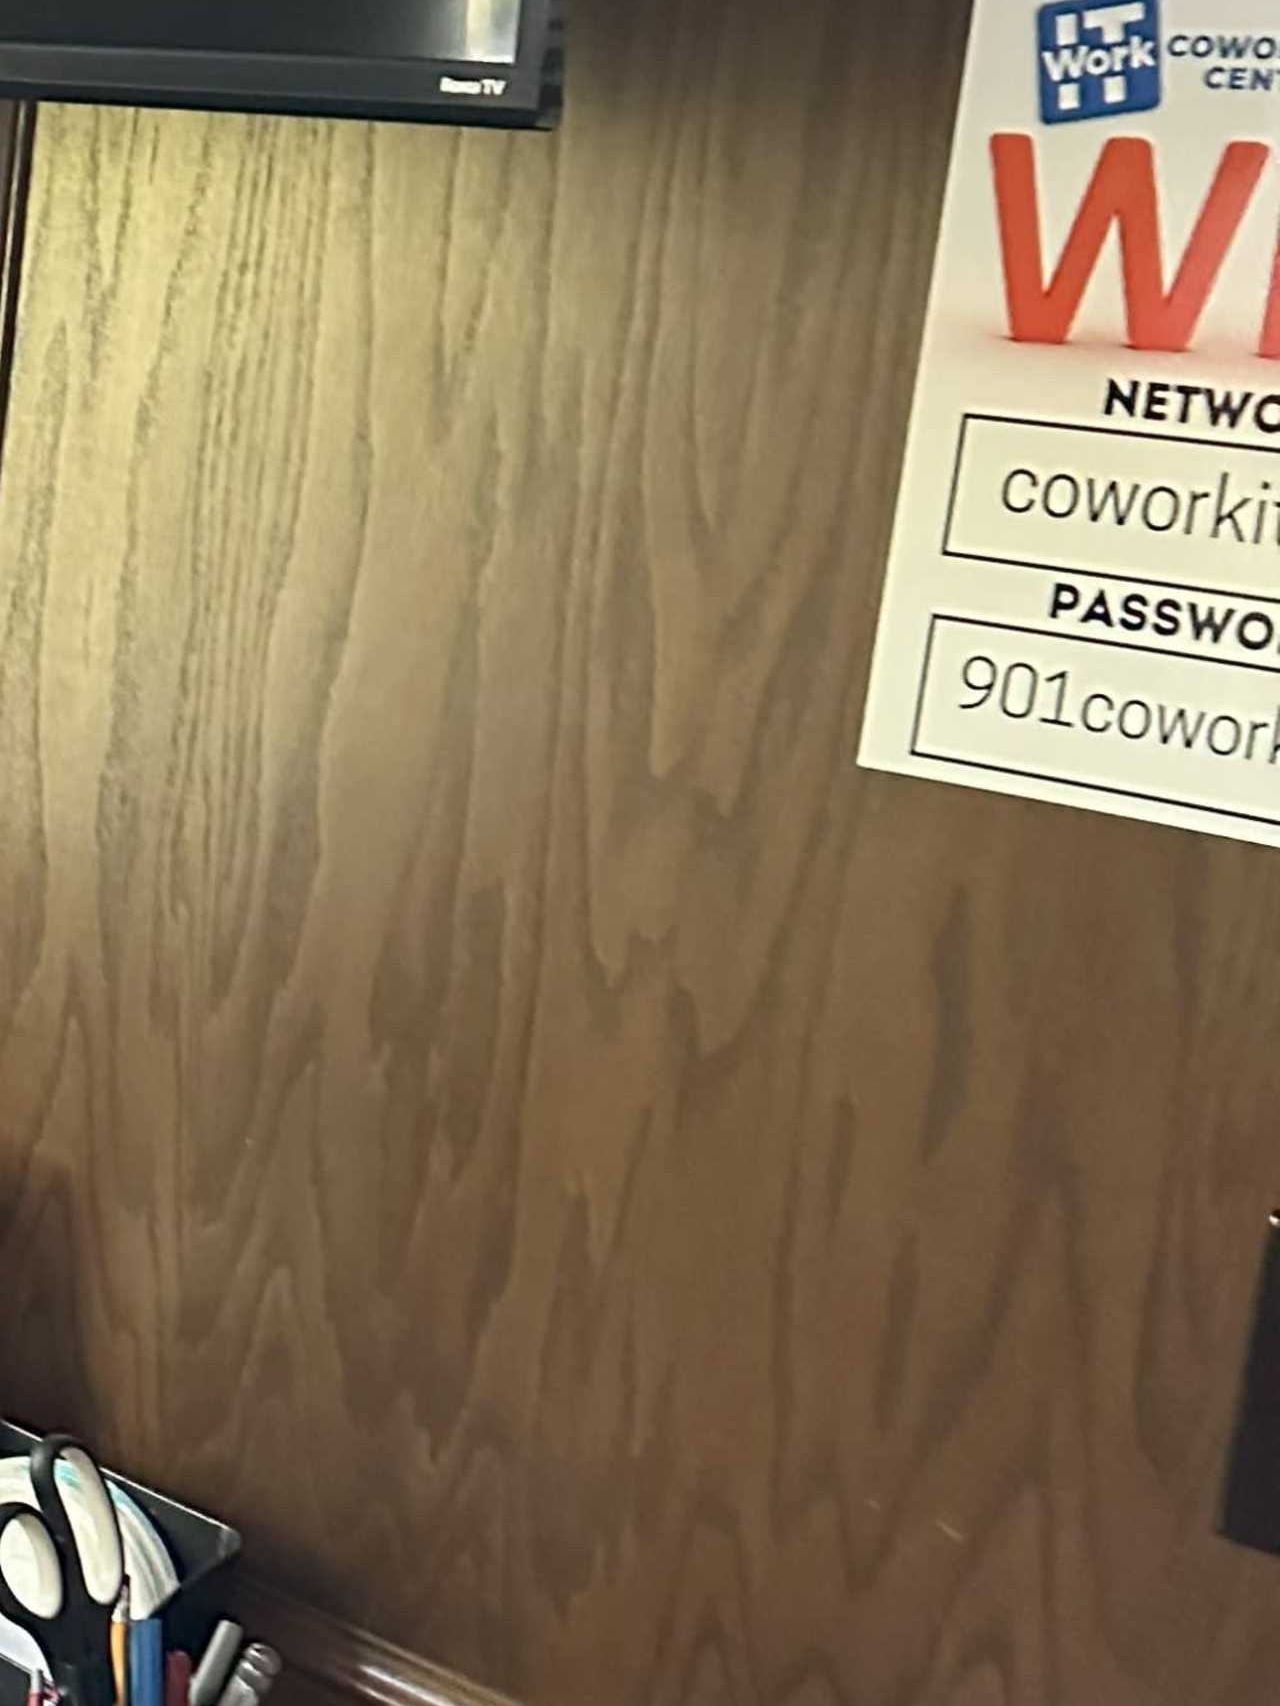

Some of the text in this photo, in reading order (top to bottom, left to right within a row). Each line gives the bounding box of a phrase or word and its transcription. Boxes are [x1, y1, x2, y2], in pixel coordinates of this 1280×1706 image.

[1041, 35, 1156, 81] Work
[1167, 34, 1280, 60] COWO
[1204, 66, 1280, 91] CEN
[989, 133, 1280, 359] W
[1103, 378, 1280, 433] NETWO
[1001, 468, 1280, 547] coworki
[1047, 582, 1280, 654] PASSWO
